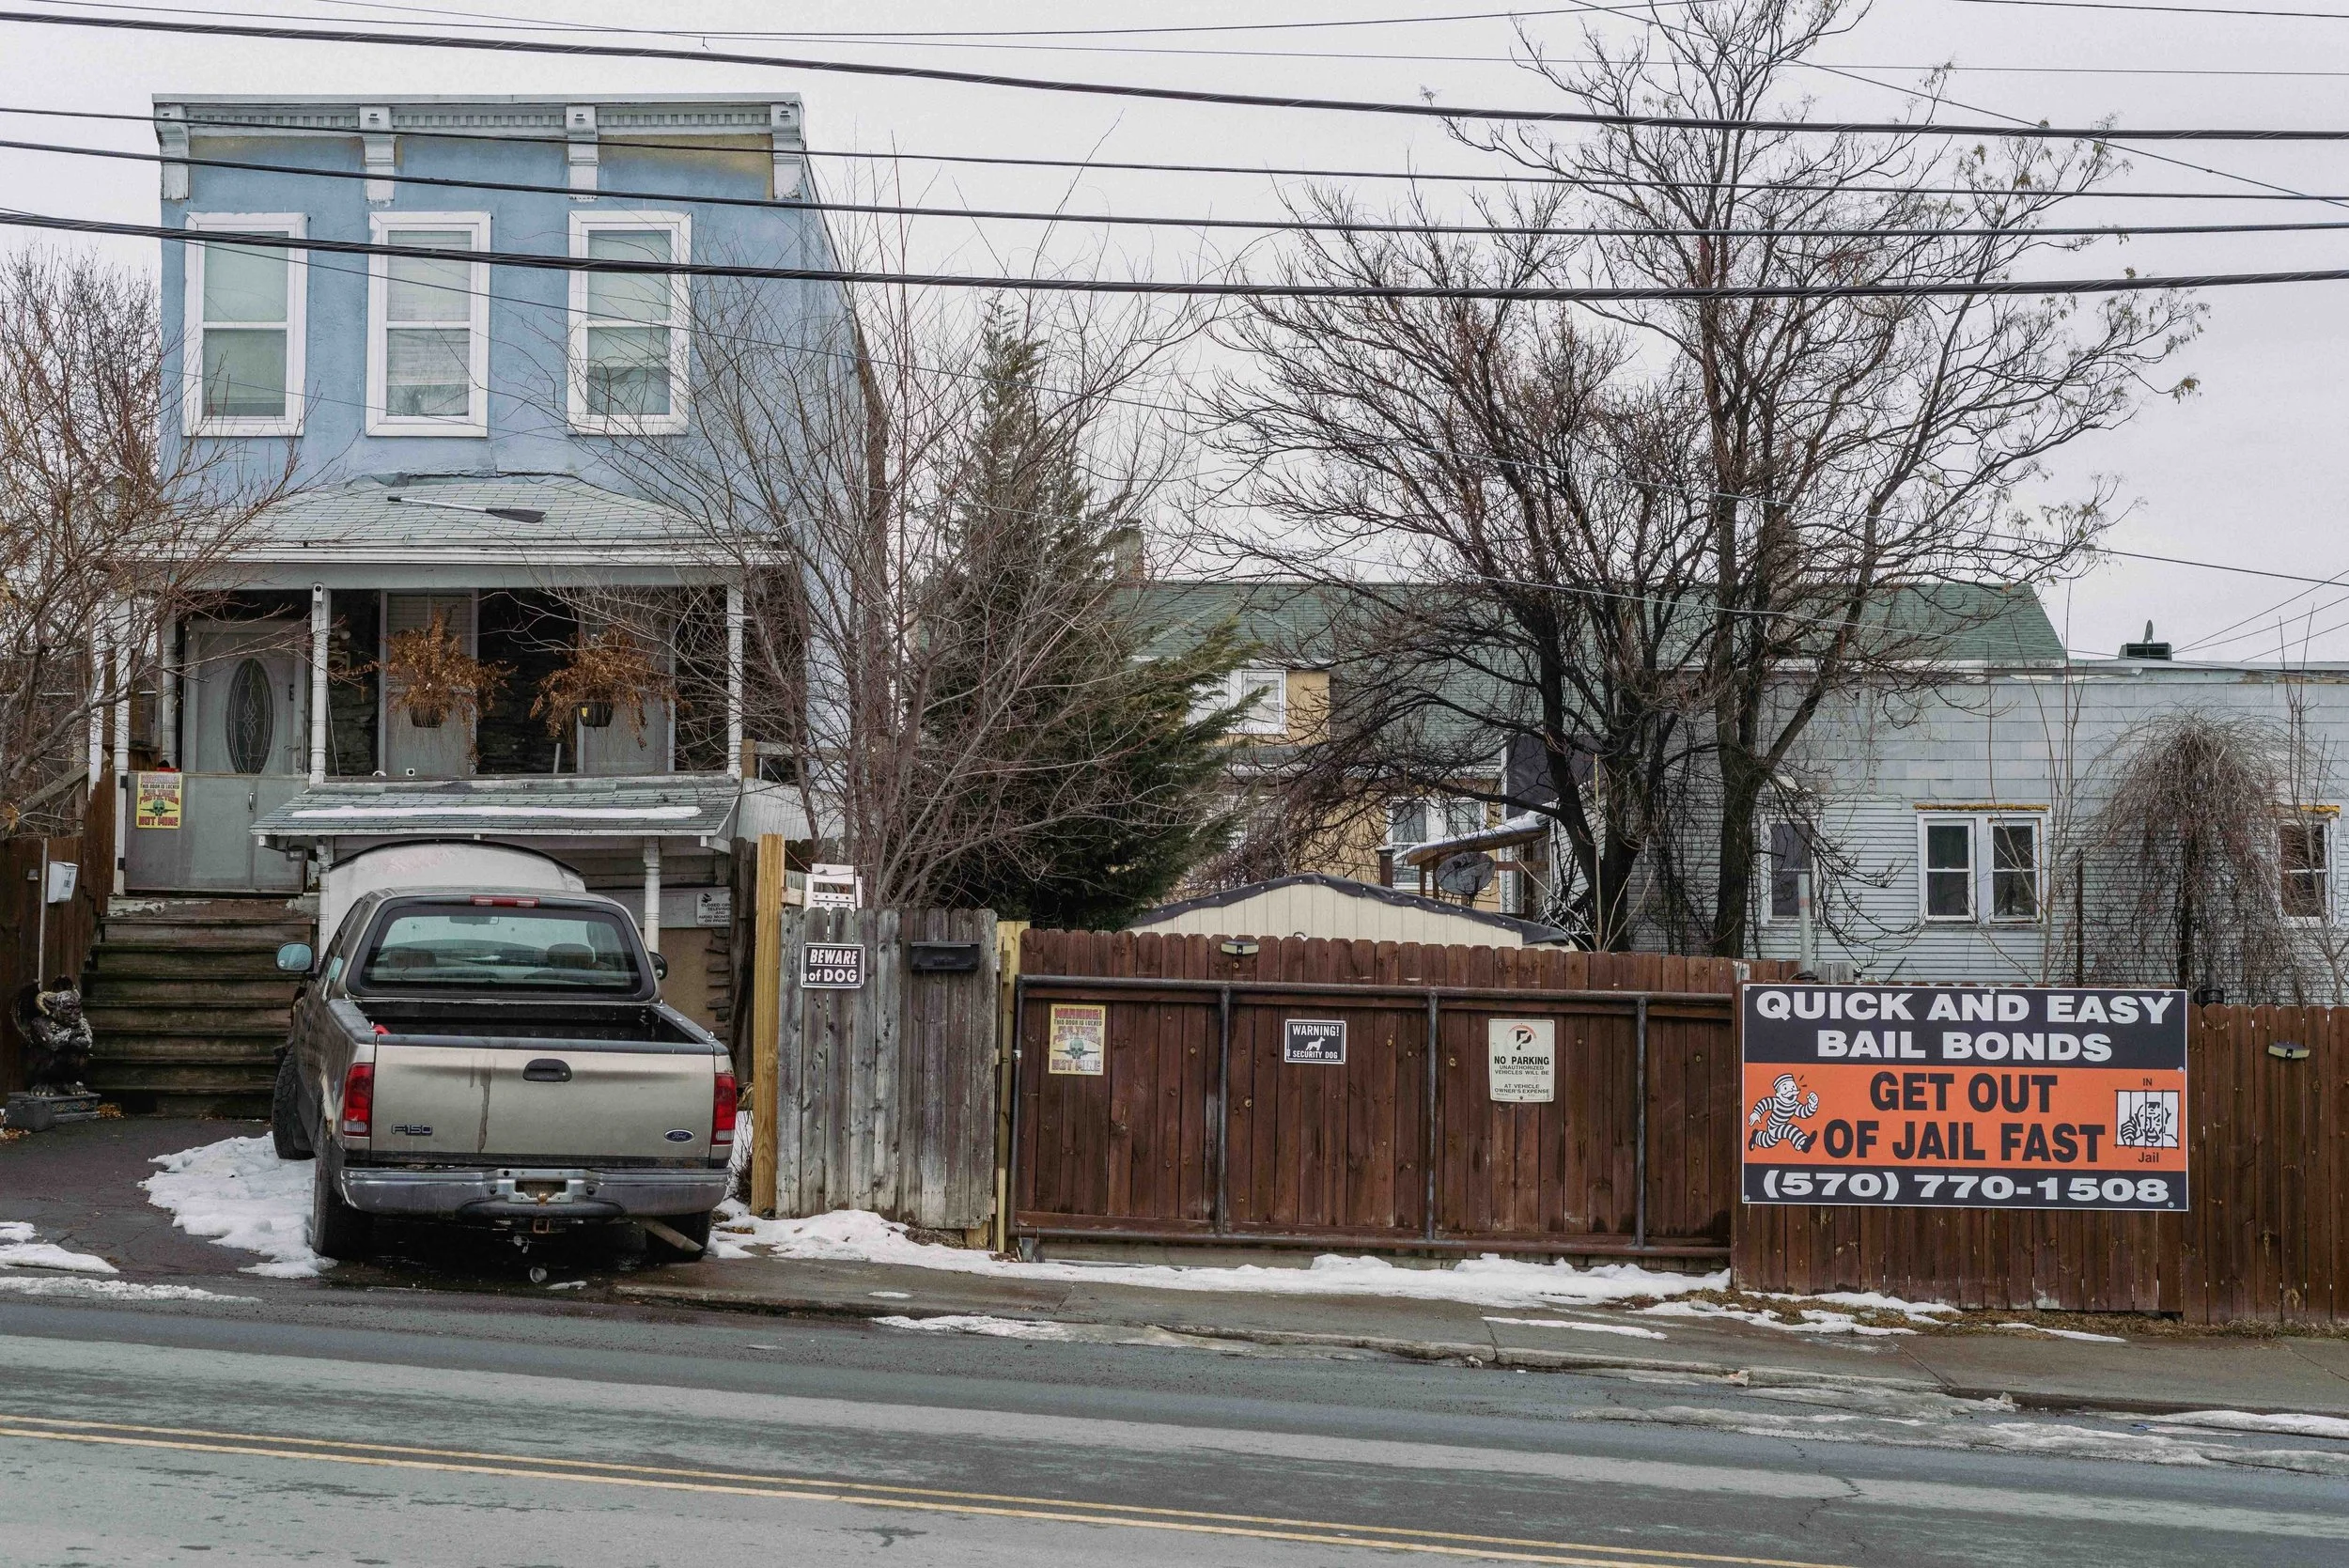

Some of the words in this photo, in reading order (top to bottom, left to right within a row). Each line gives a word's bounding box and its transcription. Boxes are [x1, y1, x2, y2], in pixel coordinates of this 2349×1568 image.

[809, 948, 858, 964] BEWARE
[808, 969, 821, 982] of
[823, 969, 858, 983] DOG
[1756, 990, 1915, 1021] QUICK
[1926, 993, 2030, 1022] AND
[2046, 995, 2174, 1024] EASY
[1292, 1024, 1340, 1036] WARNING!
[1817, 1030, 1926, 1059] BAIL
[1942, 1032, 2113, 1062] BONDS
[1292, 1049, 1323, 1059] SECURITY
[1325, 1050, 1338, 1059] DOG
[1494, 1056, 1506, 1064] NO
[1511, 1056, 1549, 1065] PARKING
[2142, 1078, 2153, 1087] IN
[1870, 1071, 1954, 1111] GET
[1968, 1072, 2058, 1113] OUT
[1823, 1118, 1879, 1158] OF
[1891, 1121, 1986, 1161] JAIL
[2000, 1123, 2106, 1163] FAST
[2138, 1152, 2159, 1163] Jail
[1763, 1170, 1900, 1201] (570)
[1914, 1174, 2170, 1203] 770-1508
